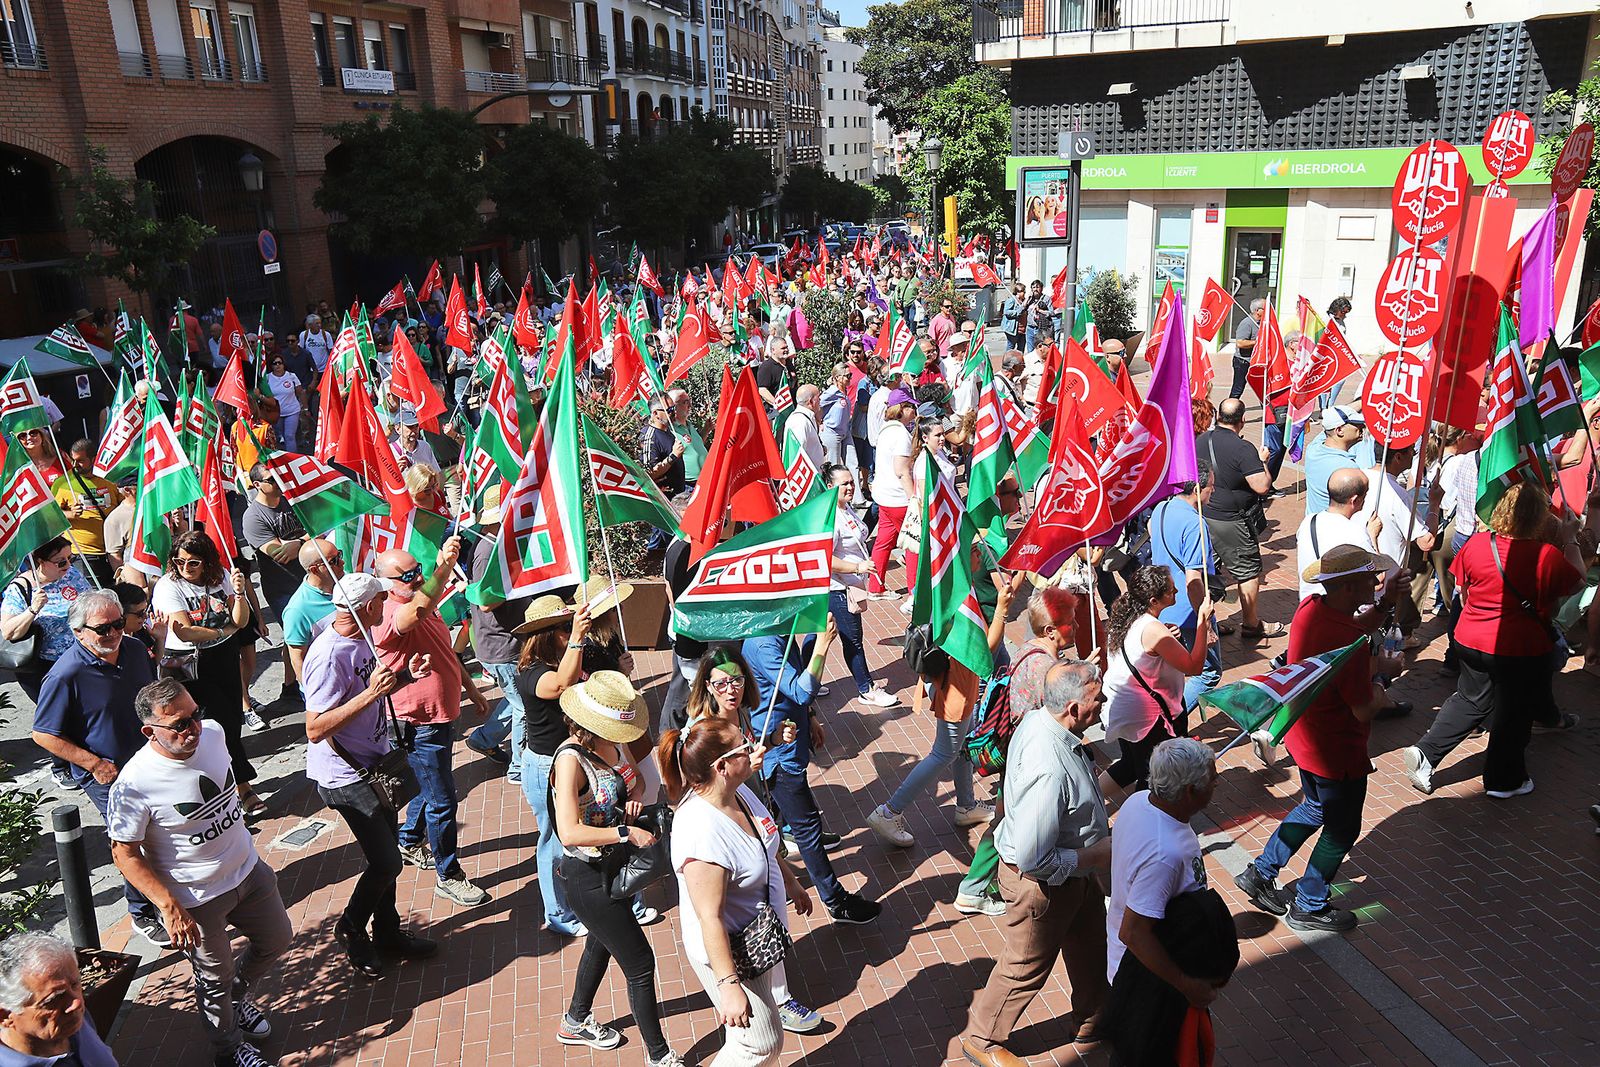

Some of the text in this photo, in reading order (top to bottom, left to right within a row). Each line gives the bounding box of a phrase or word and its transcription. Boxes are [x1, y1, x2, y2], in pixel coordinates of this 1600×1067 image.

[1490, 116, 1530, 146] UGT
[1291, 162, 1367, 175] IBERDROLA
[1404, 151, 1460, 192] UGT
[1404, 219, 1445, 235] Analucía
[1387, 256, 1442, 296] UGT
[1387, 320, 1426, 337] Andlucía
[1371, 359, 1424, 401] UGT
[1373, 420, 1411, 438] Andlucía
